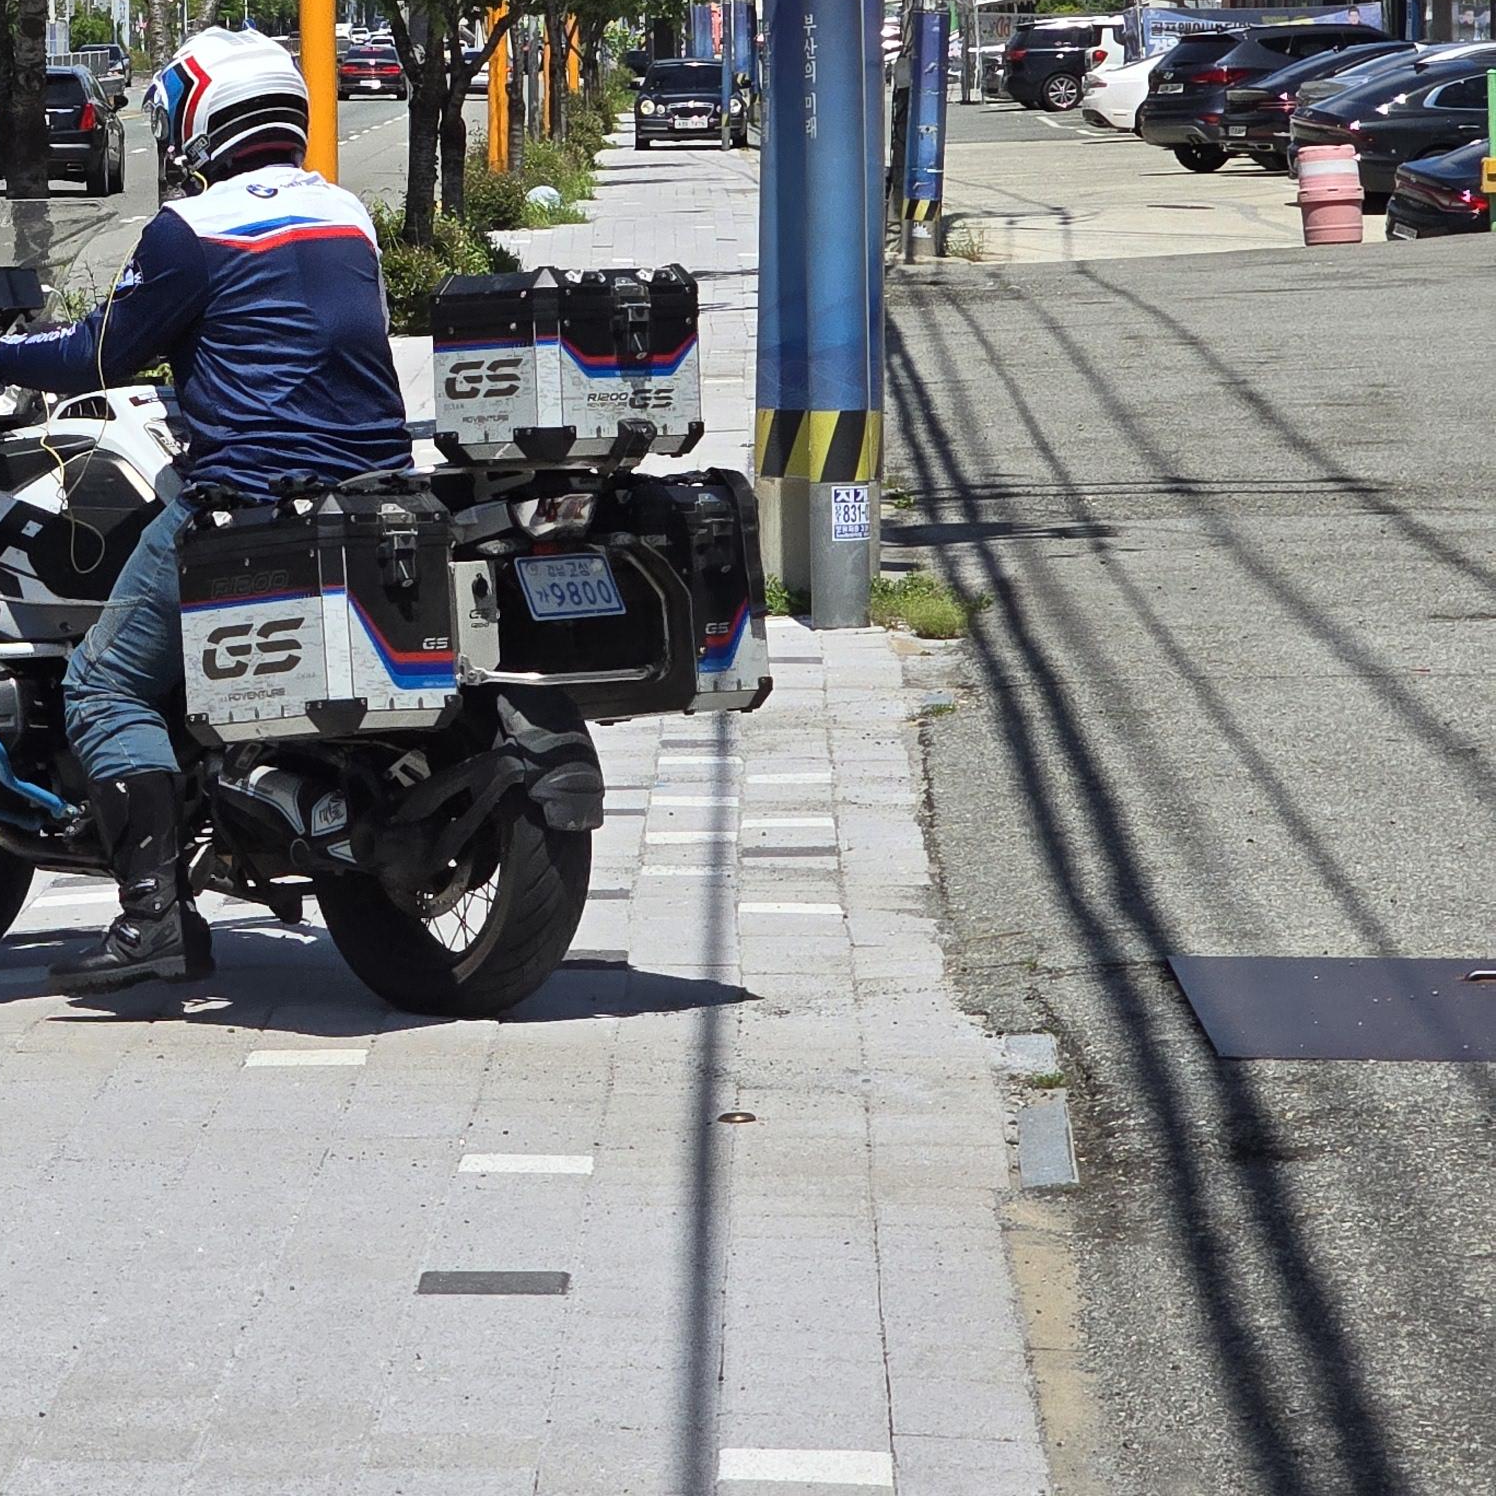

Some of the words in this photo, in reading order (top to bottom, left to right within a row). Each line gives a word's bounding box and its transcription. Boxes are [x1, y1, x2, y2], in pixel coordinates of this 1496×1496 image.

[803, 14, 818, 84] 부산의
[804, 92, 817, 140] 미래
[445, 357, 524, 400] GS
[629, 388, 675, 409] GS
[202, 617, 305, 680] GS
[422, 637, 449, 650] GS
[705, 621, 730, 635] GS
